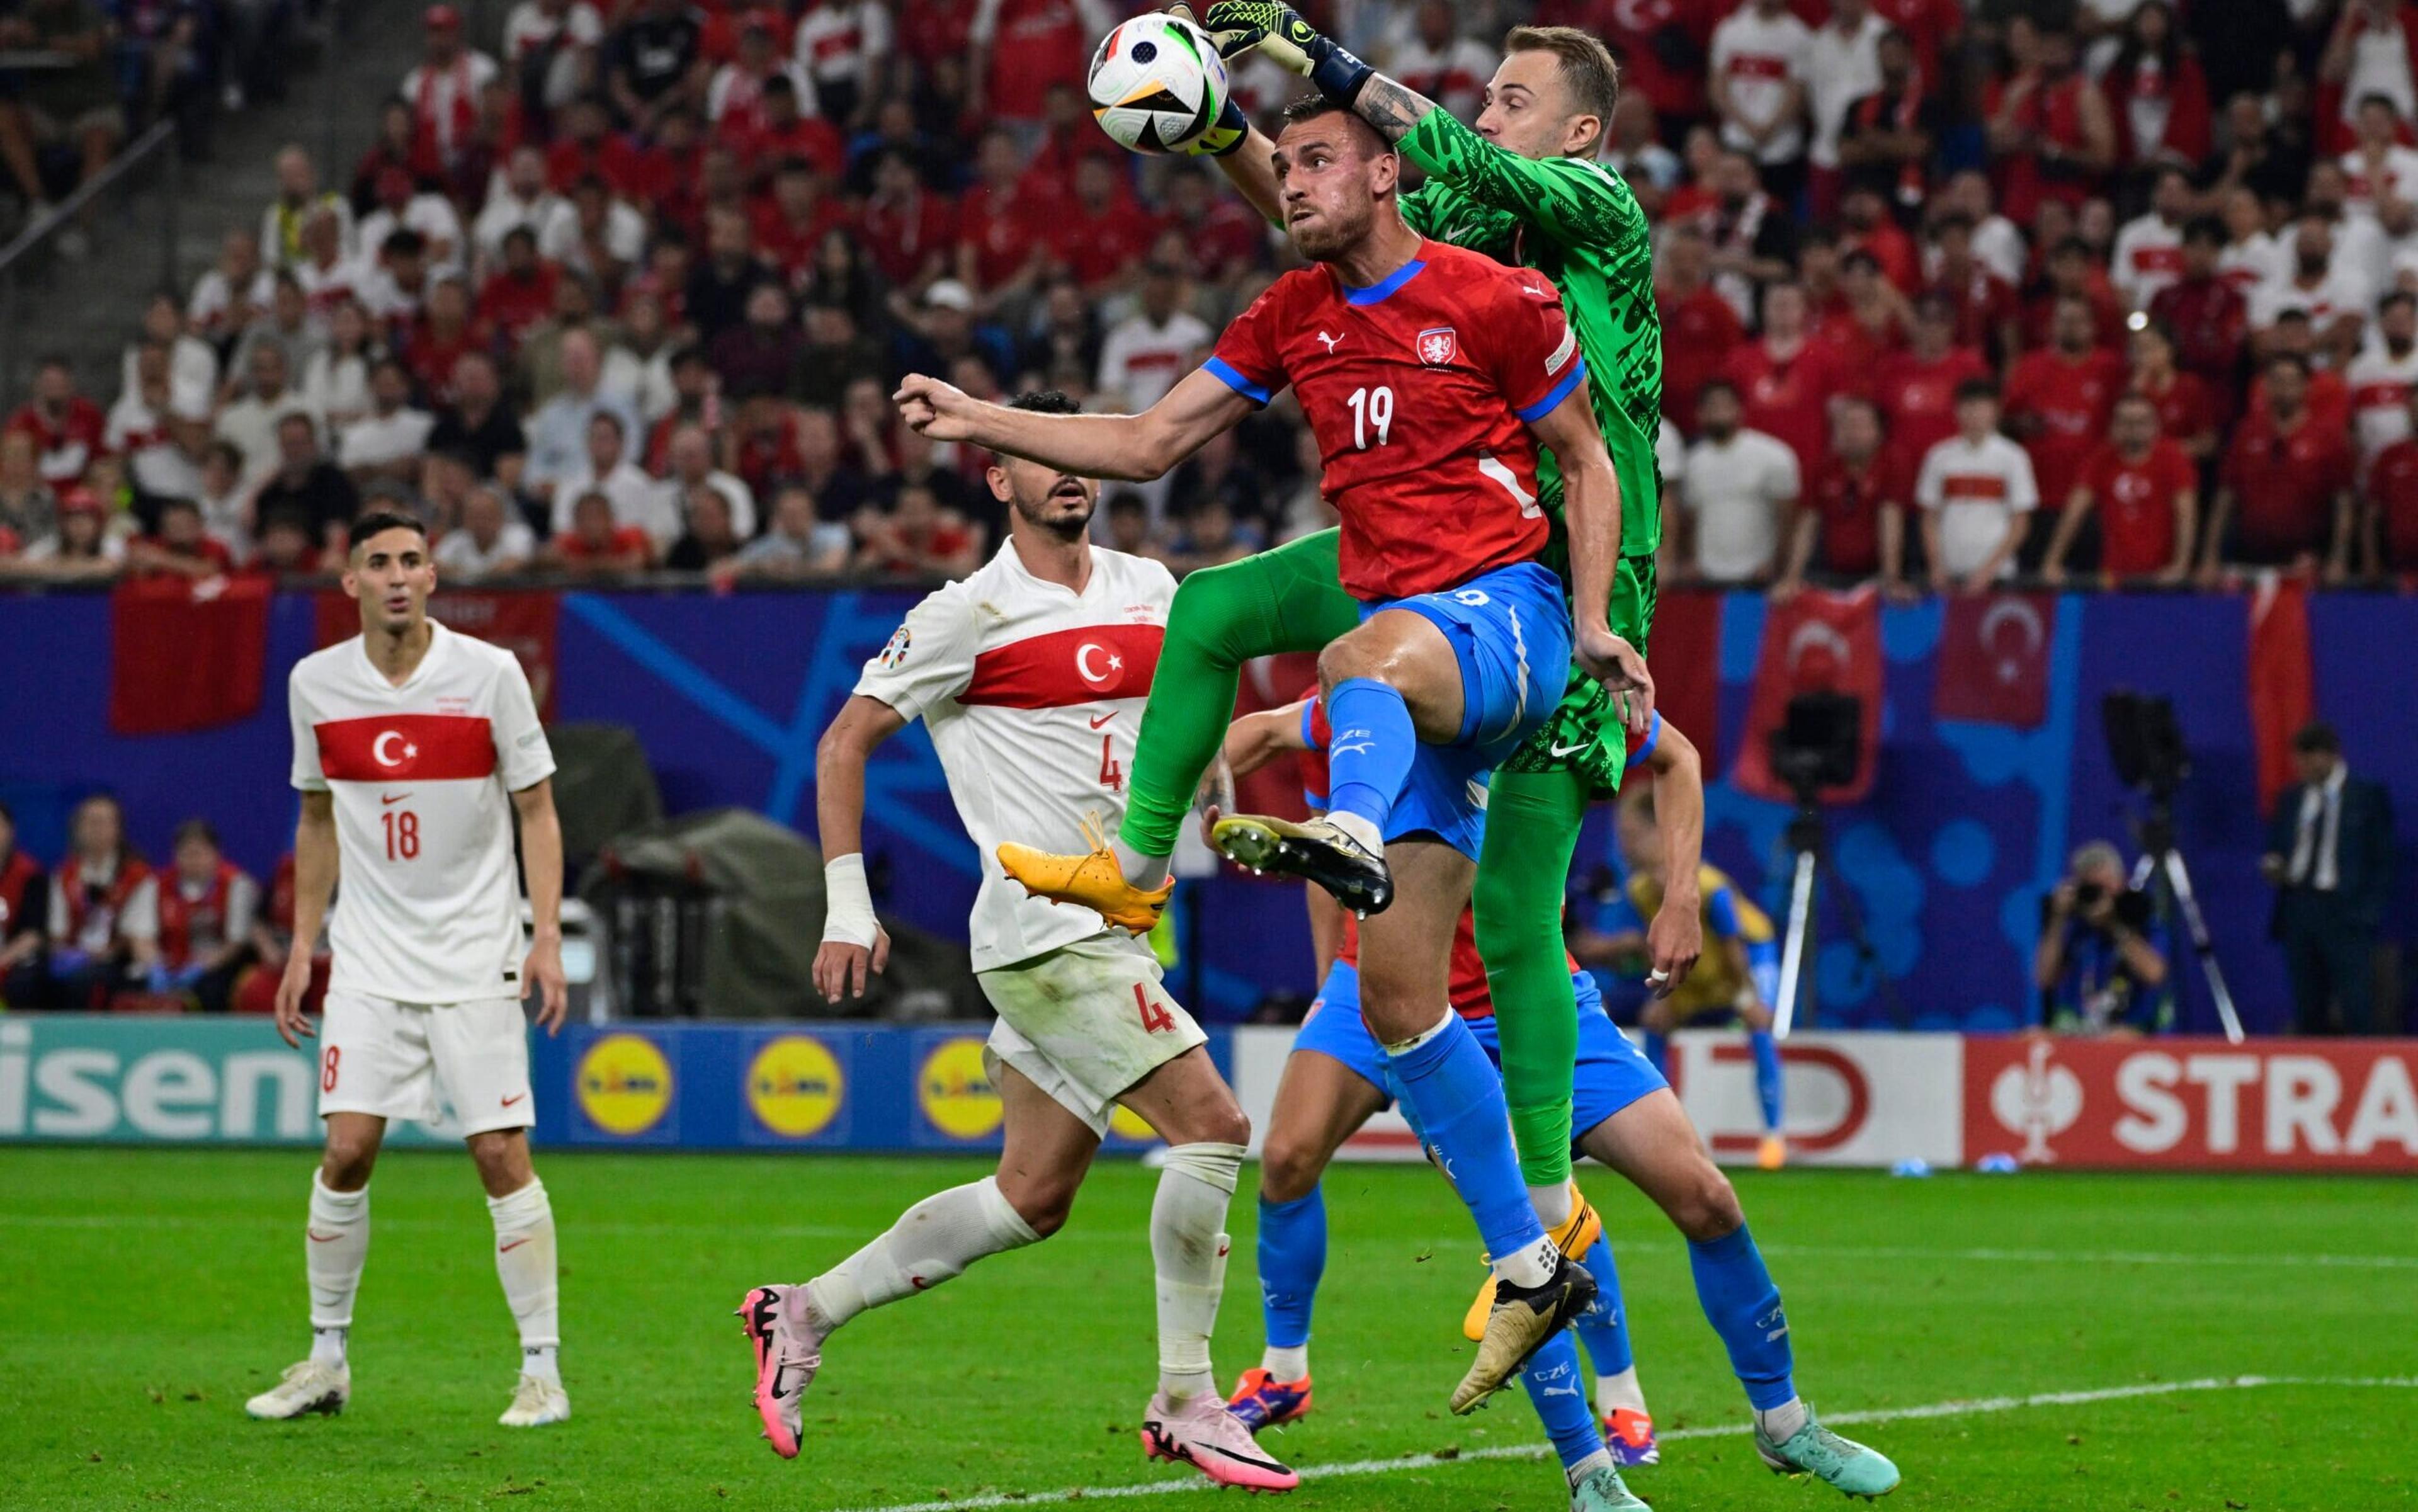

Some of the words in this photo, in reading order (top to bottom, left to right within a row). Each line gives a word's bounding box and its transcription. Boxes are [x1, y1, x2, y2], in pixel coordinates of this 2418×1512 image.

[1348, 386, 1393, 450] 19
[1100, 734, 1122, 793] 4
[381, 811, 421, 861] 18
[1133, 982, 1177, 1034] 4
[320, 1045, 341, 1093] 8
[2113, 1051, 2418, 1155] STRA
[1534, 1360, 1570, 1382] CZE
